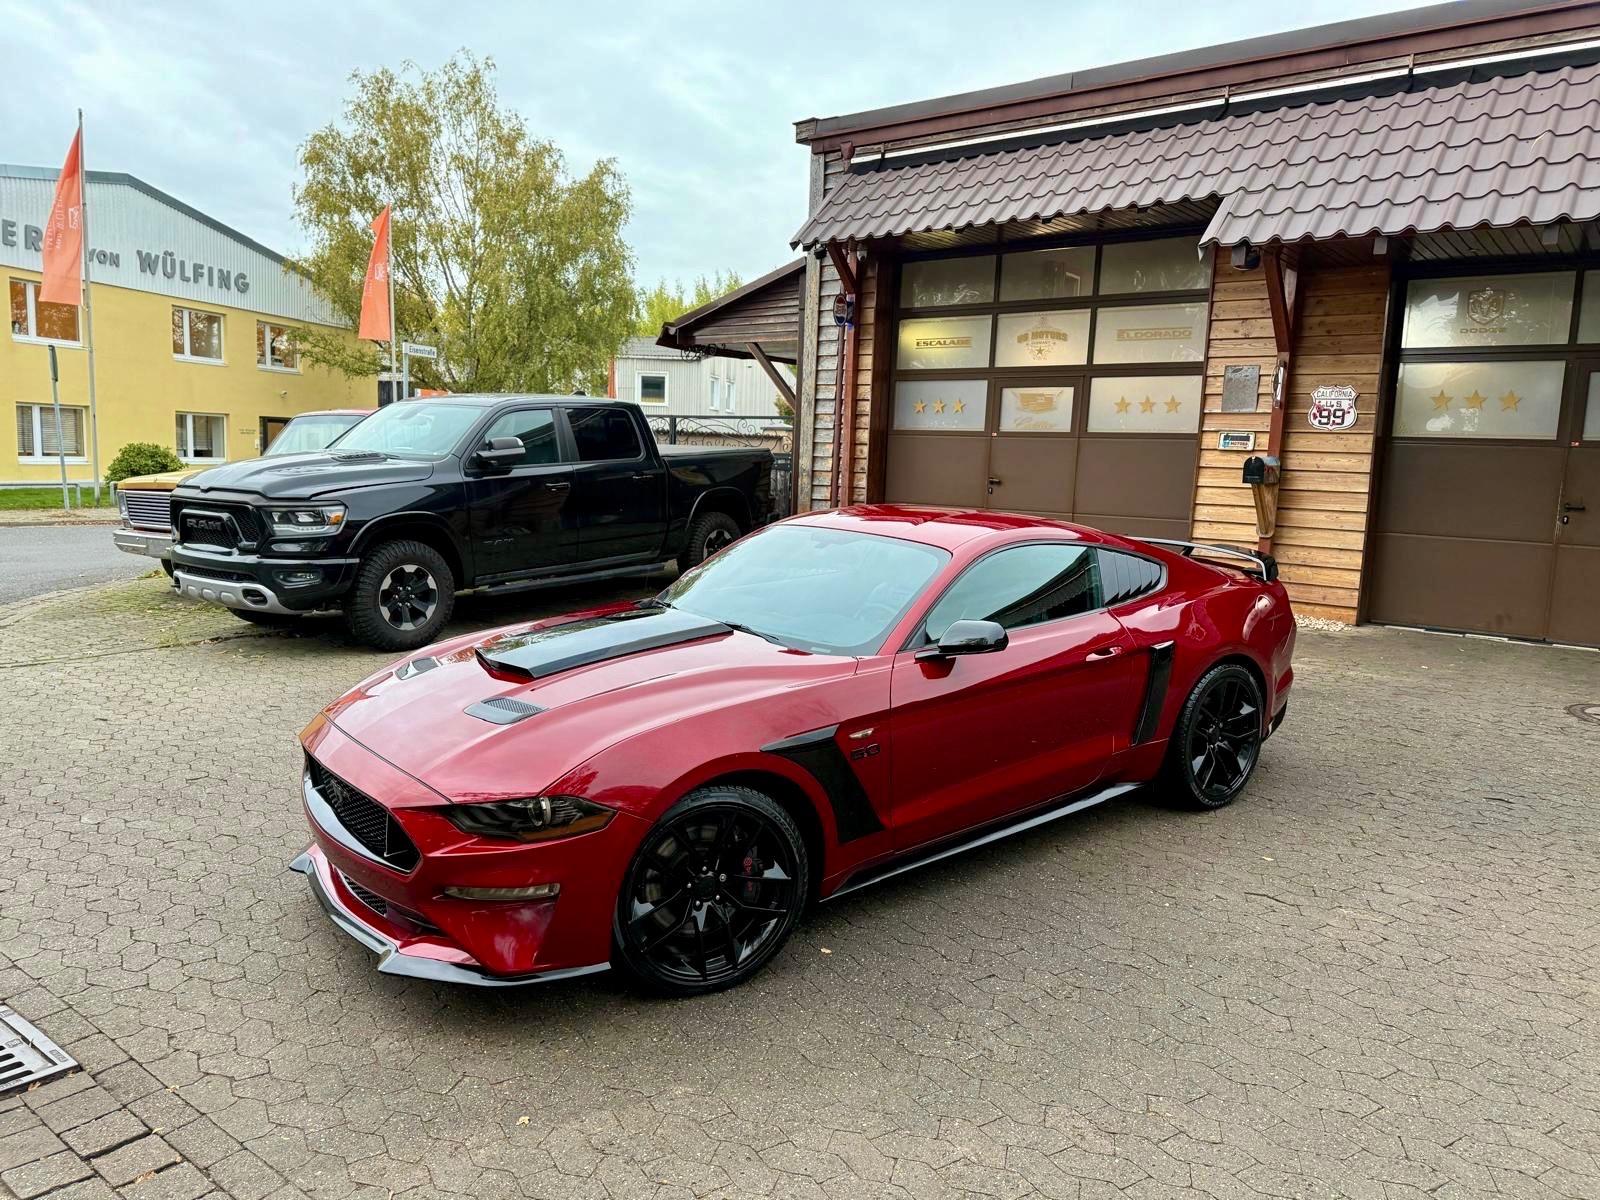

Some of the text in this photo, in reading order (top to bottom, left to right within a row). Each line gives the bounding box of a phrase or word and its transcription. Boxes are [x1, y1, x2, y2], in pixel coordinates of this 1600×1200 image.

[136, 249, 250, 294] WÜLFING
[1030, 330, 1068, 342] MOTORS
[1116, 328, 1192, 339] ELDORADO
[915, 339, 972, 347] ESCALADE
[1316, 390, 1353, 398] CALIFORNIA
[1317, 408, 1346, 426] 99
[186, 518, 222, 530] RAM
